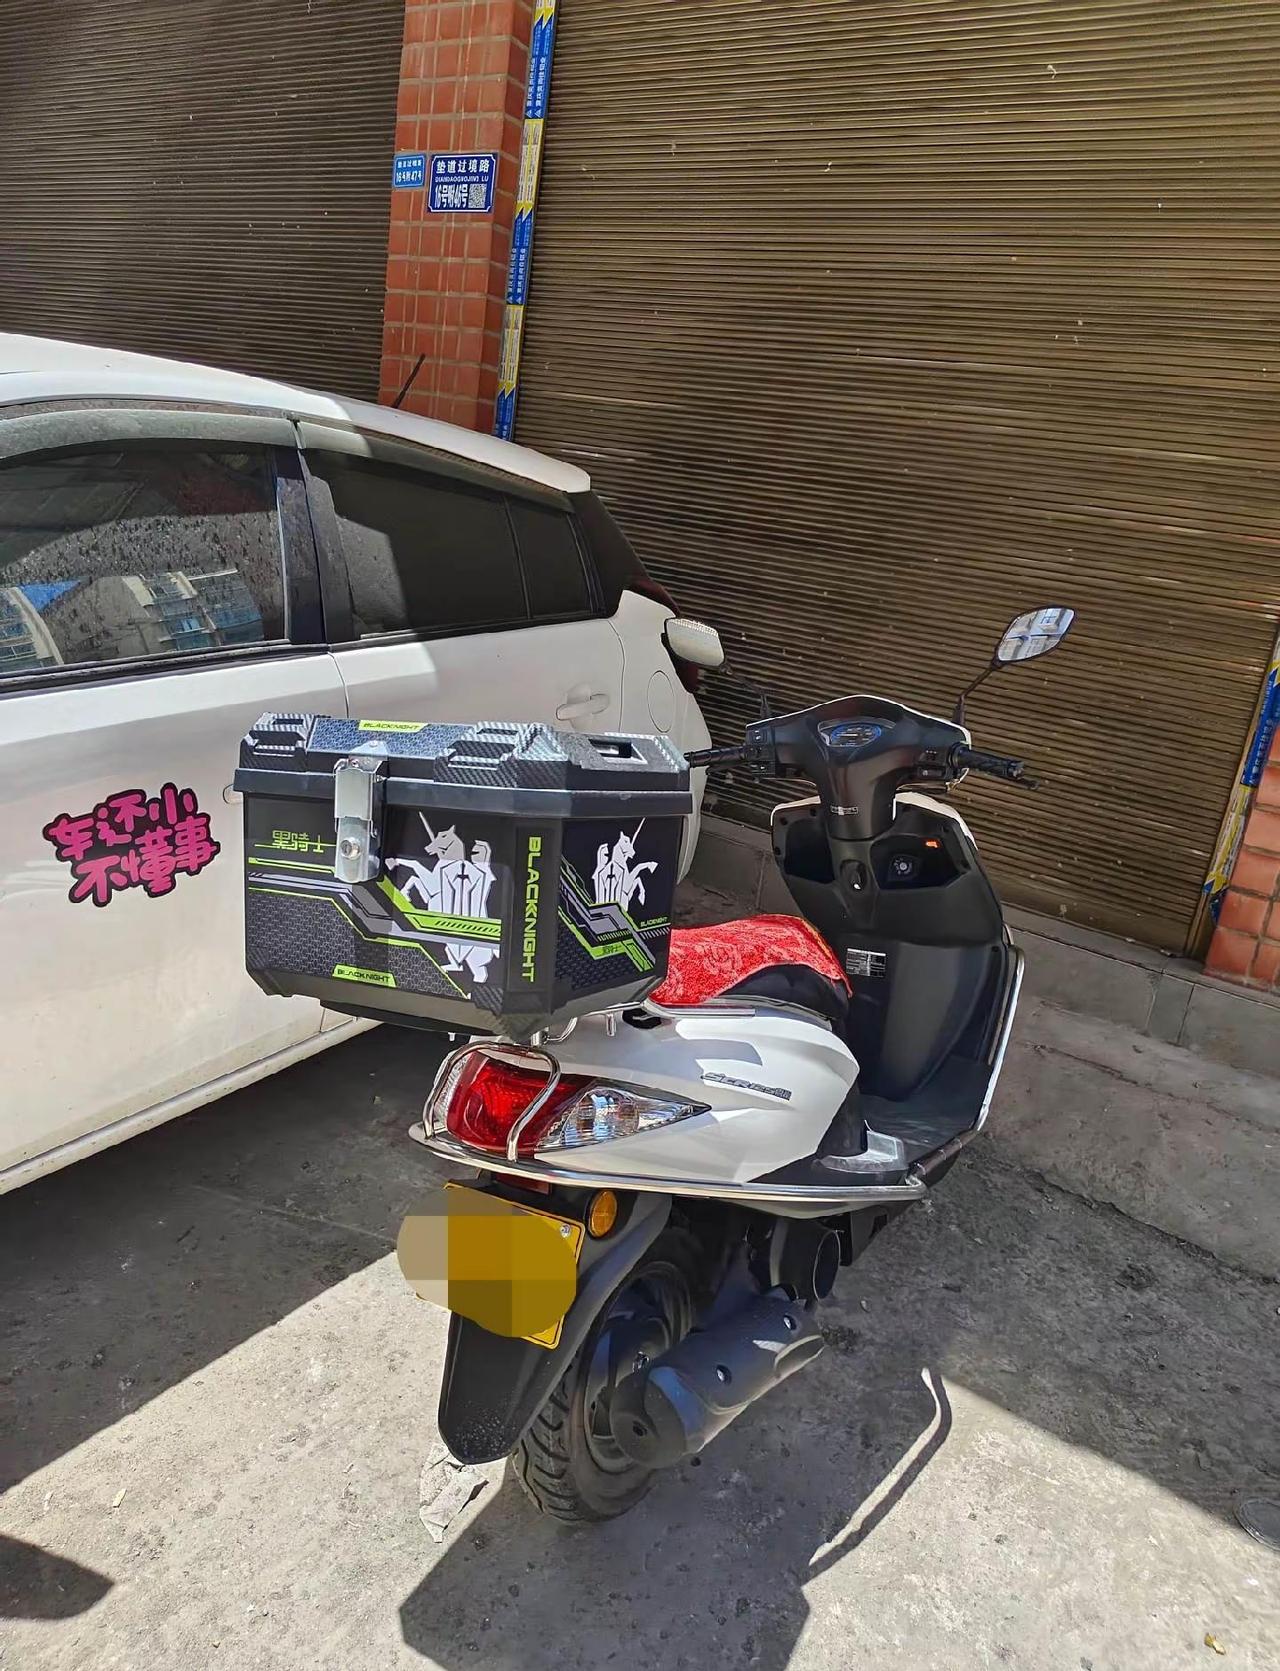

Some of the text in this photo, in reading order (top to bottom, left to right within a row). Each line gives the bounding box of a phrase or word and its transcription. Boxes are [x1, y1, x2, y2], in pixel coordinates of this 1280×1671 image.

[436, 159, 490, 173] 垫道过境路
[520, 836, 542, 983] BLACKNIGHT
[337, 968, 390, 983] BLACKNIGHT
